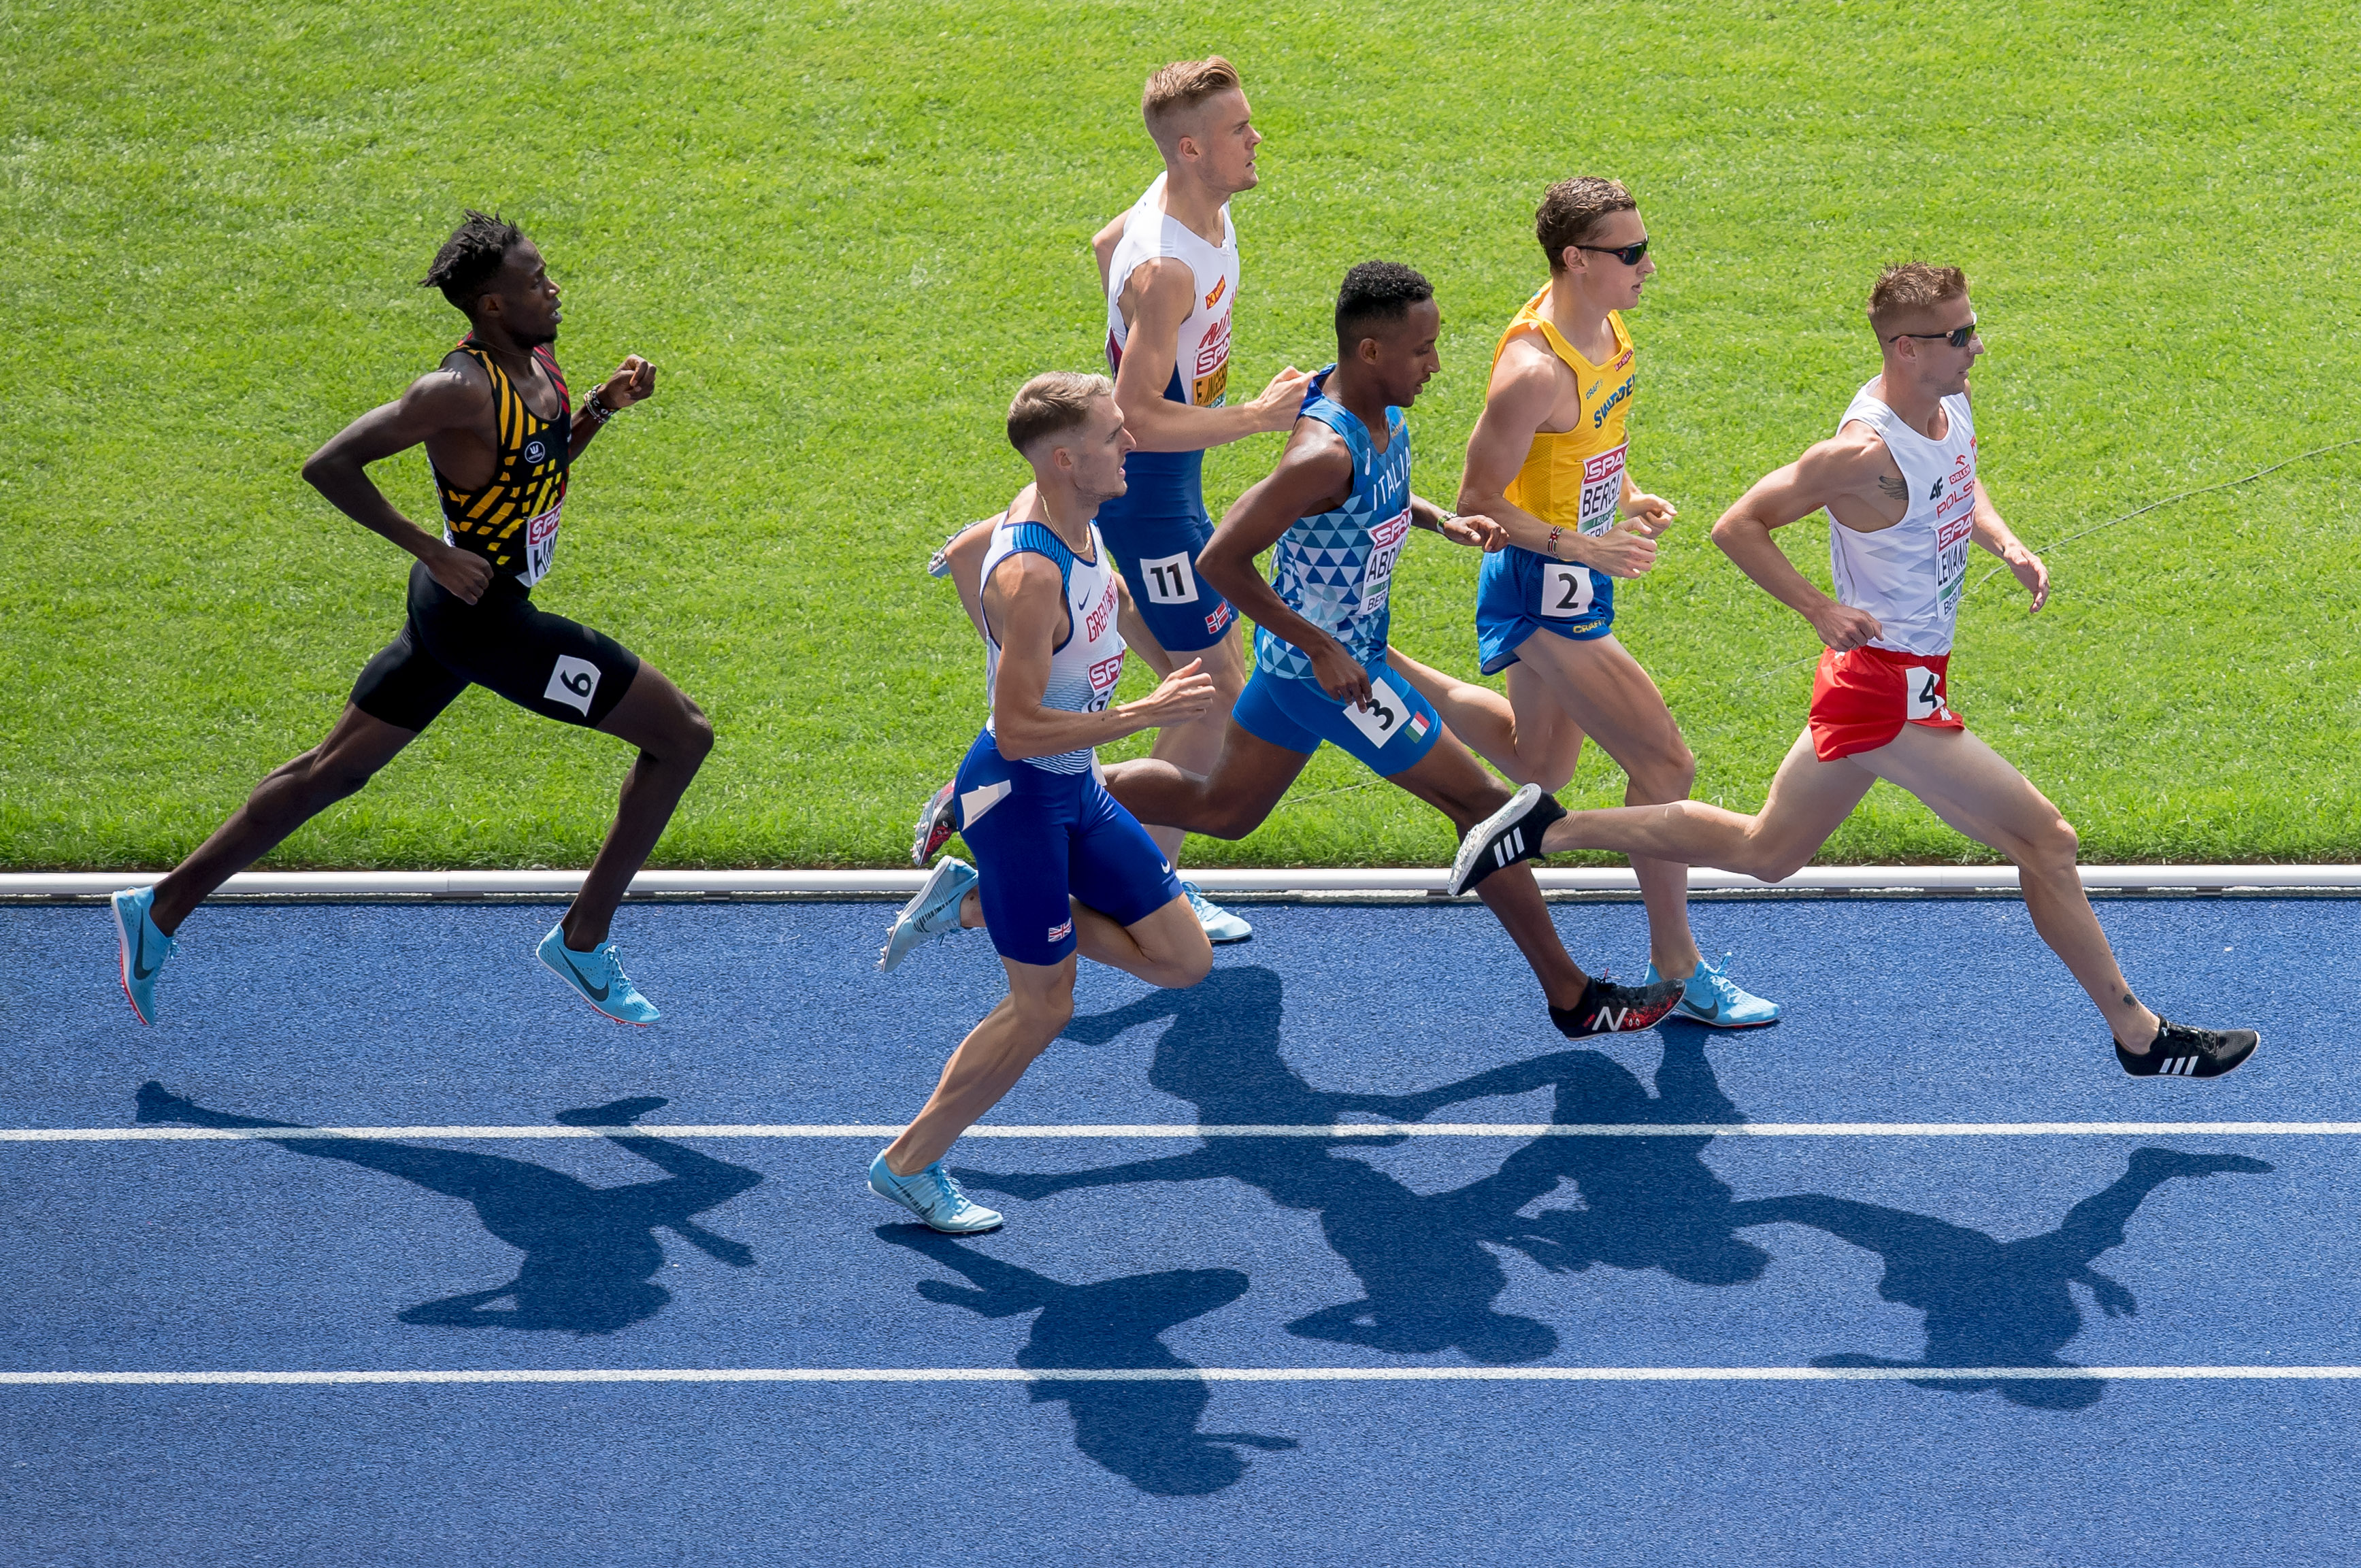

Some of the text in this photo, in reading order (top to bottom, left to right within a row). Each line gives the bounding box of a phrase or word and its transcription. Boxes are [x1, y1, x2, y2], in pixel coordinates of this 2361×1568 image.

[1373, 446, 1412, 512] ITALIA
[1949, 465, 1971, 484] ORLEN
[1150, 562, 1185, 597] 11
[1555, 573, 1579, 610] 2
[1085, 593, 1109, 643] GREAT
[560, 669, 592, 698] 6
[1919, 673, 1938, 709] 4
[1366, 698, 1395, 731] 3
